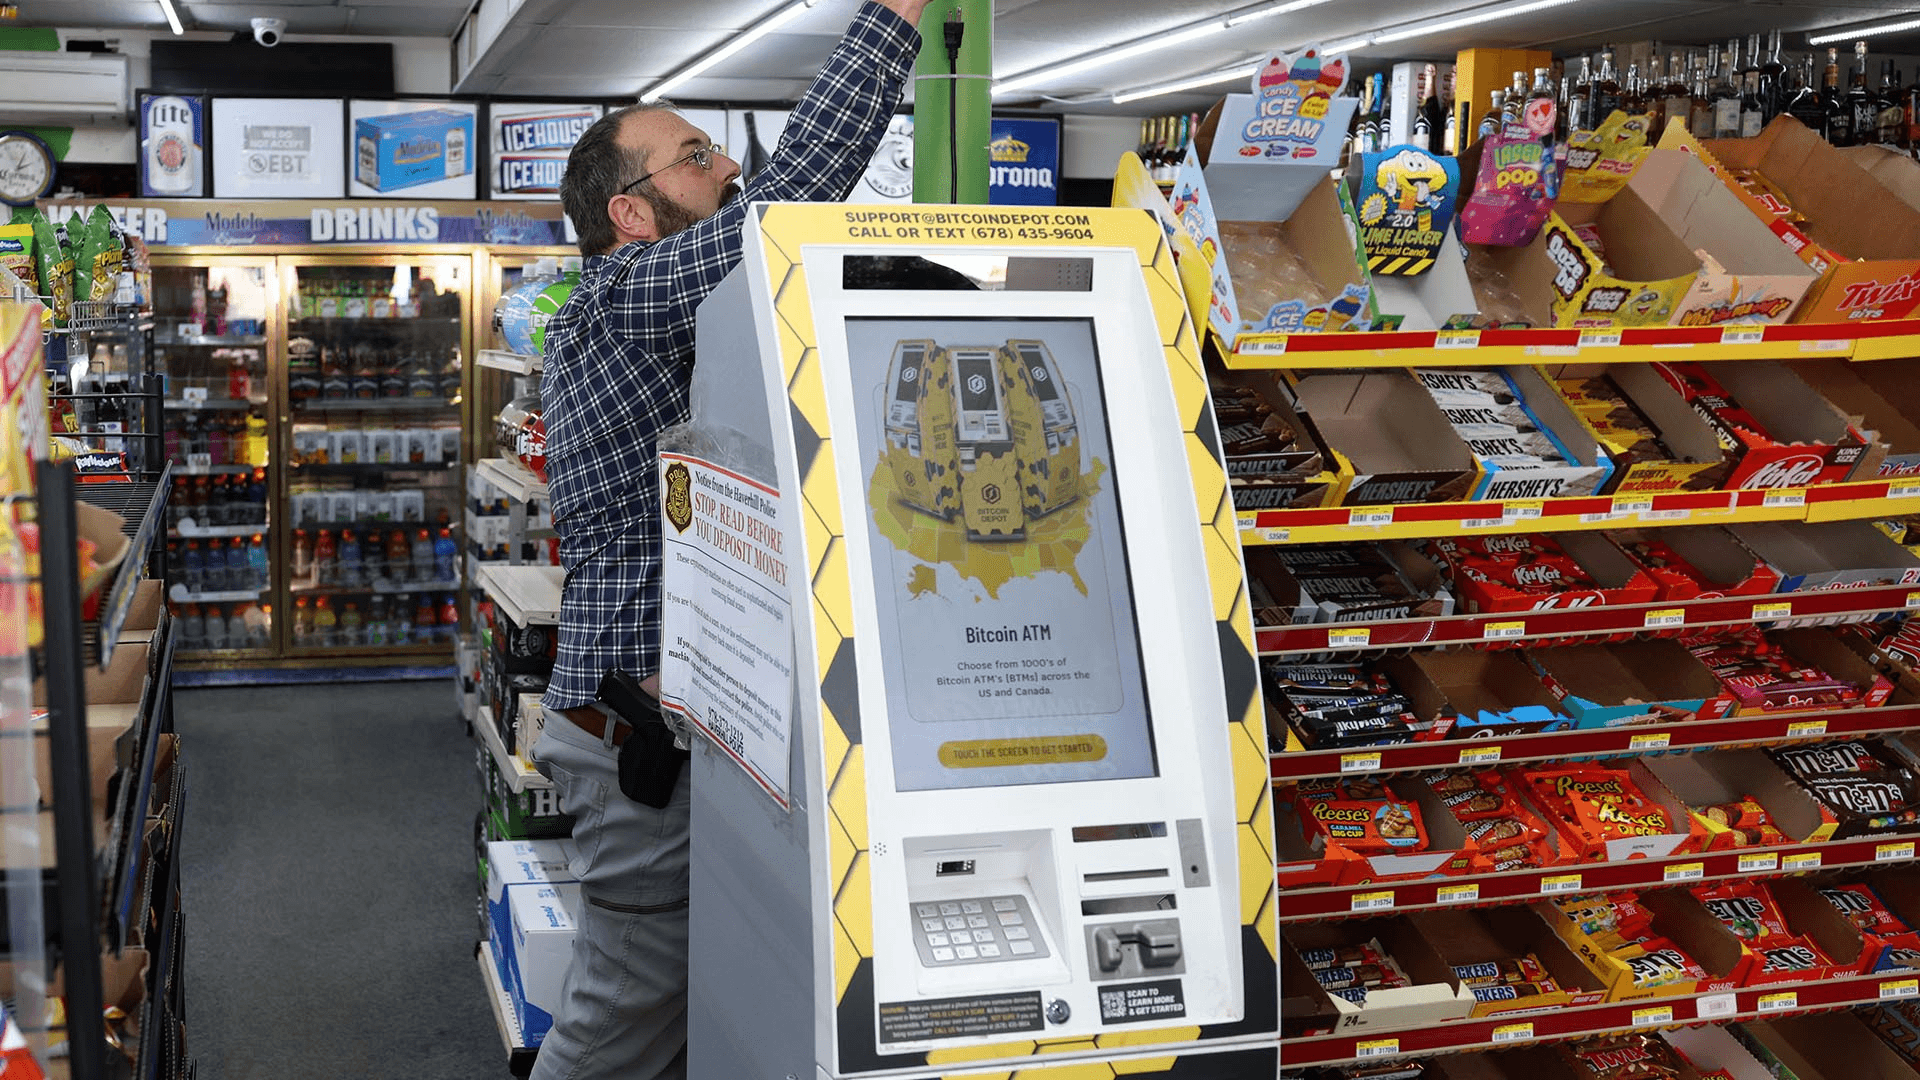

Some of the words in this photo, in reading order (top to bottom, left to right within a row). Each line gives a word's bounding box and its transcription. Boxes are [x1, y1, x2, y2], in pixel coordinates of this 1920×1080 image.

[153, 104, 190, 128] Lite
[1260, 99, 1298, 117] ICE
[1246, 117, 1321, 140] CREAM
[269, 155, 306, 174] EBT
[990, 166, 1054, 189] rona
[206, 211, 265, 232] Modelo
[311, 207, 440, 241] DRINKS
[475, 208, 534, 230] Modelo
[845, 211, 1090, 226] SUPPORT@BITCOINDEPOT.COM
[1392, 215, 1414, 227] 2.0
[848, 226, 892, 239] CALL
[896, 227, 920, 239] OR
[924, 227, 966, 240] TEXT
[971, 226, 1014, 240] (678)
[1017, 226, 1094, 241] 435-9604
[1361, 227, 1392, 246] LIME
[1394, 230, 1443, 246] LICKER
[1378, 245, 1400, 257] Liquid
[1402, 247, 1430, 259] Candy
[1809, 256, 1828, 274] 12
[1271, 313, 1302, 327] ICE
[1420, 373, 1478, 391] RSHEY'S
[1443, 408, 1500, 425] SHEY'S
[1693, 403, 1716, 432] KING
[1716, 426, 1738, 453] SIZE
[1466, 438, 1524, 456] SHEY'S
[1837, 448, 1862, 456] KING
[695, 470, 712, 490] Notice
[712, 477, 724, 497] from
[724, 482, 734, 500] the
[734, 486, 759, 511] Haverhill
[760, 497, 777, 519] Police
[1358, 479, 1436, 501] HERSHEY'S
[1486, 477, 1564, 500] HERSHEY'S
[981, 515, 1008, 523] DEPOT
[720, 502, 745, 533] READ
[747, 515, 783, 555] BEFORE
[695, 517, 713, 544] YOU
[713, 525, 753, 566] DEPOSIT
[754, 547, 788, 587] MONEY
[966, 625, 1018, 644] Bitcoin
[1022, 624, 1051, 642] ATM
[957, 661, 993, 671] Choose
[995, 659, 1019, 669] from
[1021, 658, 1055, 668] 1000's
[1057, 657, 1068, 667] of
[937, 676, 971, 686] Bitcoin
[974, 674, 1003, 684] ATM's
[1041, 673, 1072, 682] across
[1074, 671, 1091, 680] the
[978, 689, 992, 698] US
[995, 688, 1013, 697] and
[1016, 686, 1053, 696] Canada.
[1288, 707, 1304, 727] 24
[954, 748, 979, 760] TOUCH
[982, 748, 996, 758] THE
[998, 747, 1029, 758] SCREEN
[1030, 746, 1041, 756] TO
[1042, 745, 1057, 755] GET
[1058, 743, 1093, 754] STARTED
[1556, 776, 1624, 796] Reese's
[1311, 801, 1371, 823] Reese's
[1331, 830, 1346, 838] BIG
[1347, 830, 1365, 838] CUP
[1579, 944, 1597, 963] 24
[1315, 967, 1355, 984] CKERS
[1127, 989, 1148, 998] SCAN
[1149, 988, 1159, 997] TO
[1128, 996, 1153, 1006] LEARN
[1154, 995, 1176, 1005] MORE
[1471, 984, 1517, 1002] CKERS
[1129, 1007, 1136, 1016] &
[1136, 1006, 1151, 1016] GET
[1152, 1003, 1184, 1014] STARTED
[1343, 1015, 1358, 1027] 24
[1586, 1046, 1653, 1072] TWIX
